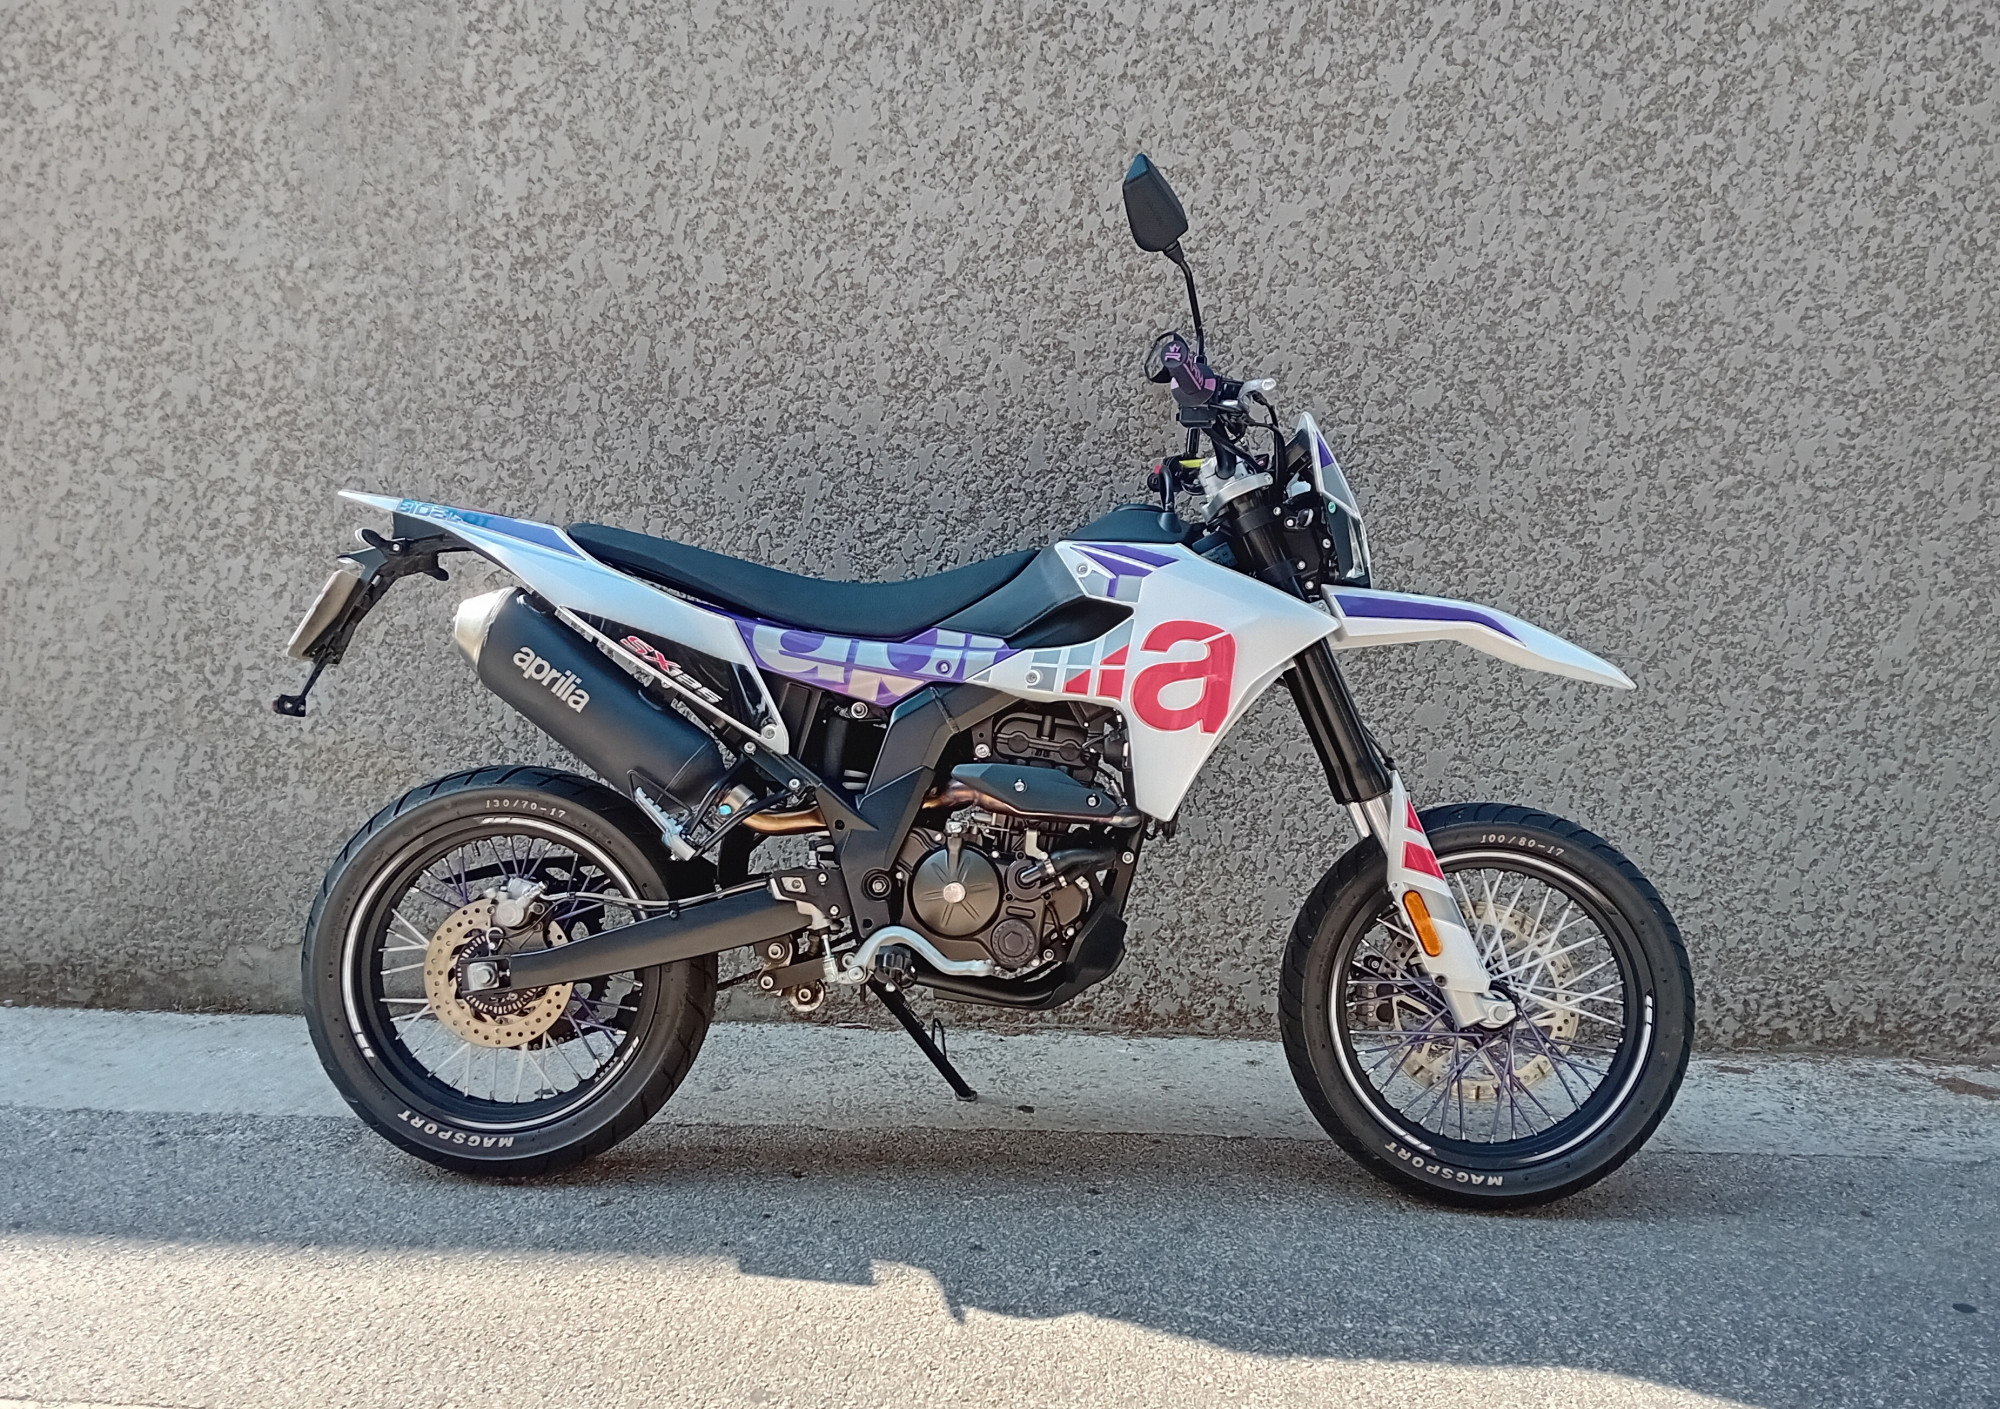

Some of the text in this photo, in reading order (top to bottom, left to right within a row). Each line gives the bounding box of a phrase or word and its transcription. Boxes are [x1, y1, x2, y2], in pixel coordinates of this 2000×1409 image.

[512, 646, 590, 713] aprilia
[486, 799, 566, 818] 130/70-17
[1480, 834, 1565, 857] 100/80-17
[397, 1109, 515, 1148] MAGSPORT
[1384, 1141, 1503, 1186] MAGSPORT
